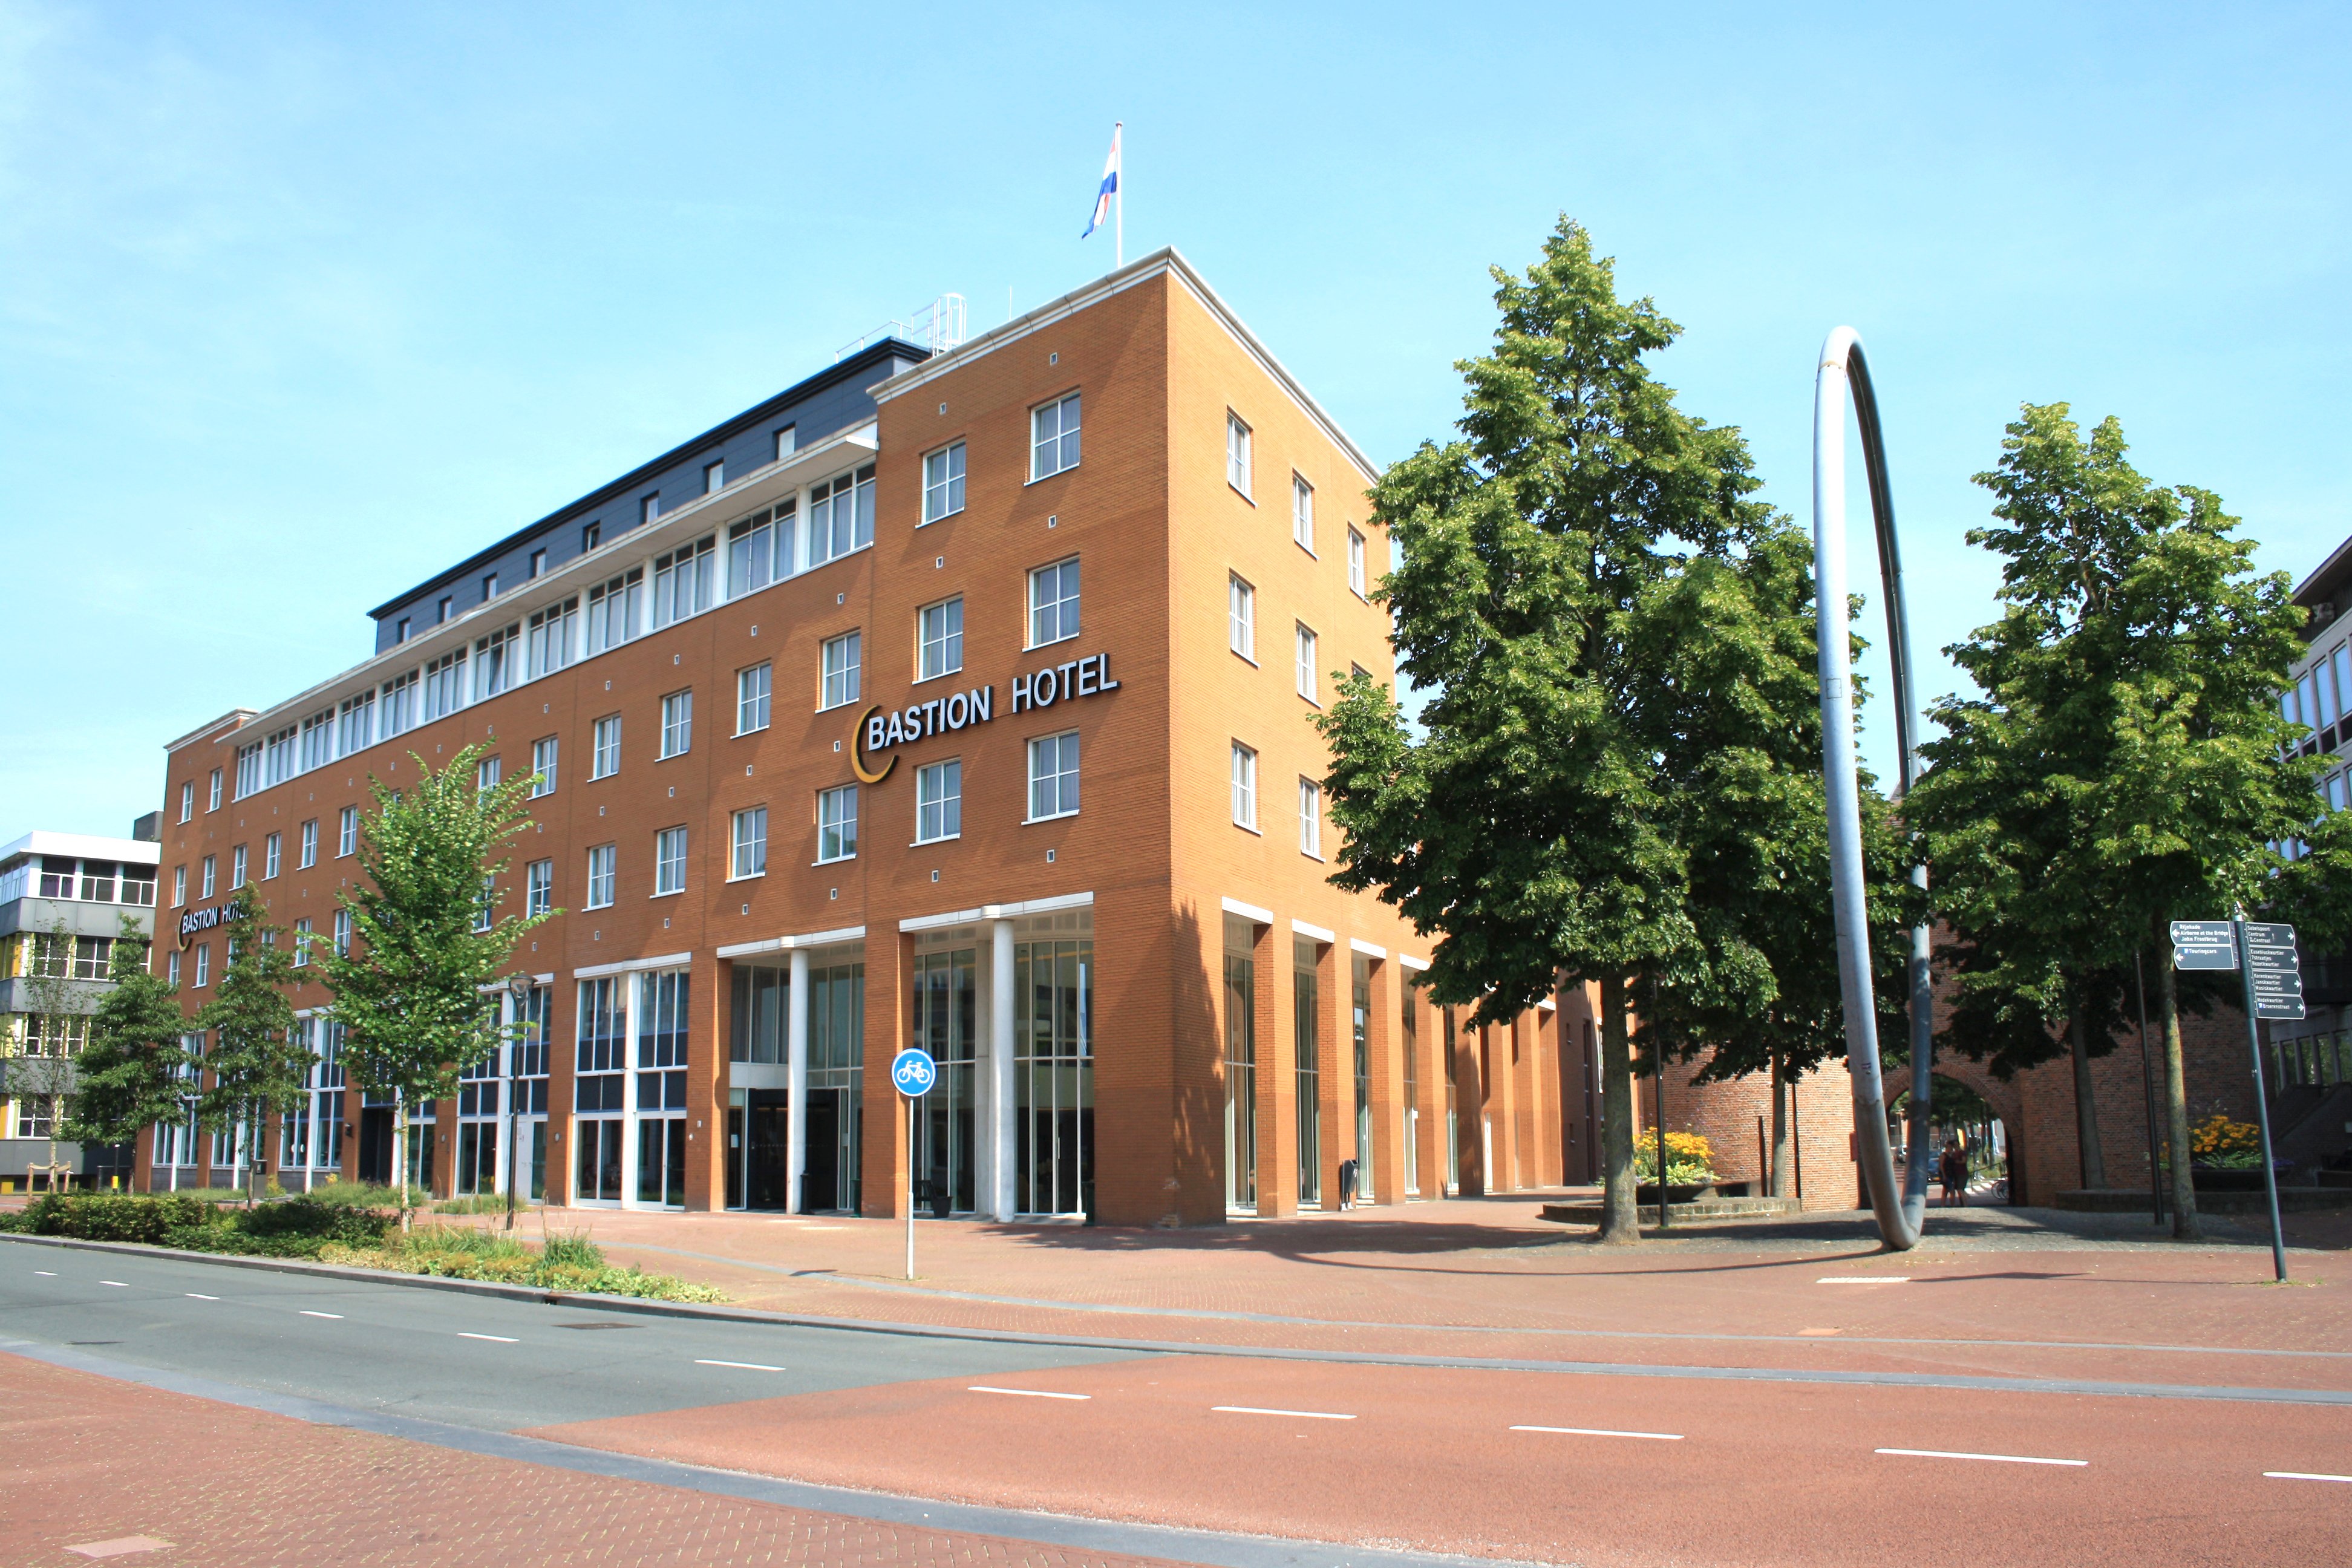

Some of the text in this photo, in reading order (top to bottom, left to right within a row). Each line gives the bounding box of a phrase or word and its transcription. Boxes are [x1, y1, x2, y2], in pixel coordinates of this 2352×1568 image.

[868, 653, 1119, 751] BASTION HOTEL
[182, 900, 249, 934] BASTION HOT
